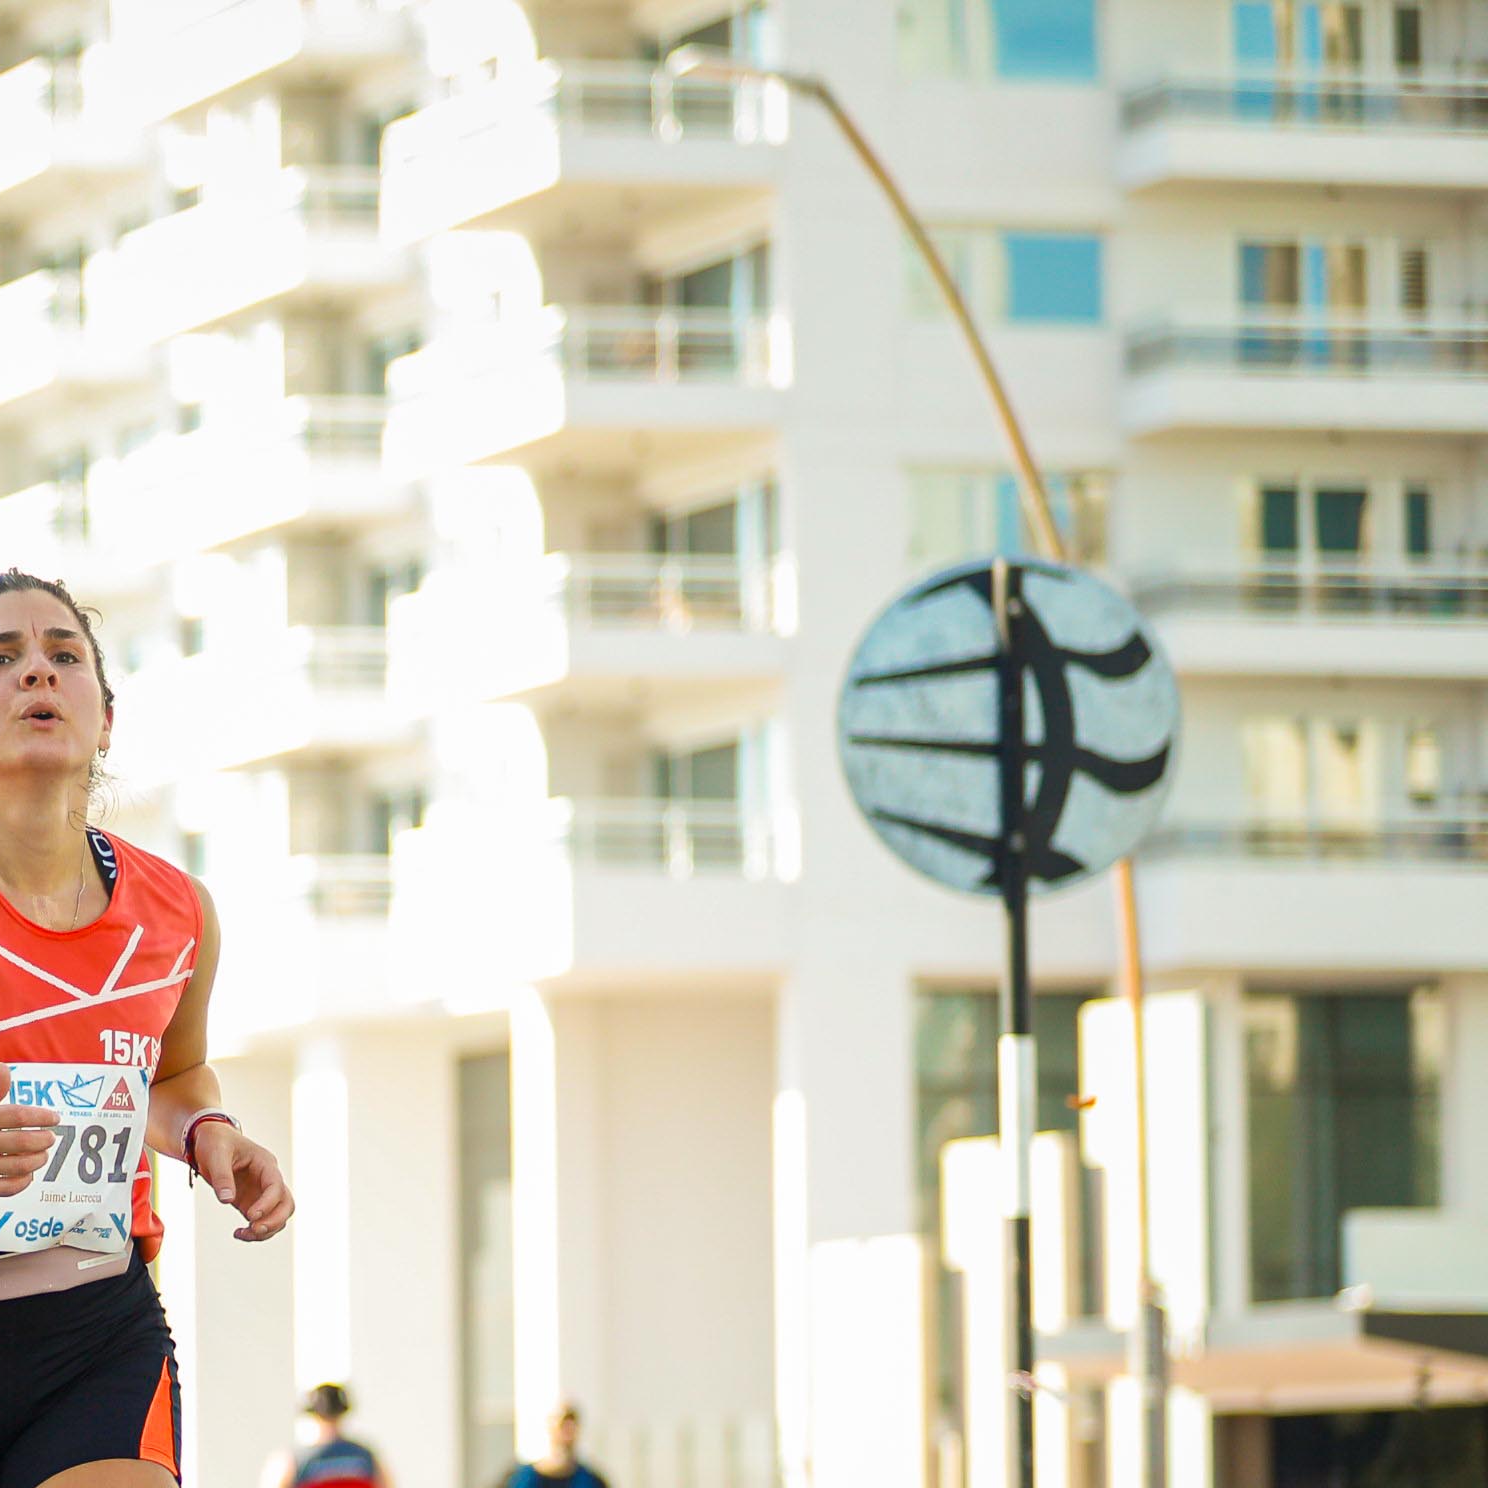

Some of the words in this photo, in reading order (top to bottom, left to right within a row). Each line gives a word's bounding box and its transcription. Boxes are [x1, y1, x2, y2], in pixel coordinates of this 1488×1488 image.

[99, 1029, 151, 1067] 15K
[9, 1080, 55, 1107] 15K
[112, 1092, 130, 1107] 15K
[42, 1125, 132, 1185] 781
[40, 1190, 66, 1203] Jaime
[15, 1216, 64, 1241] osde
